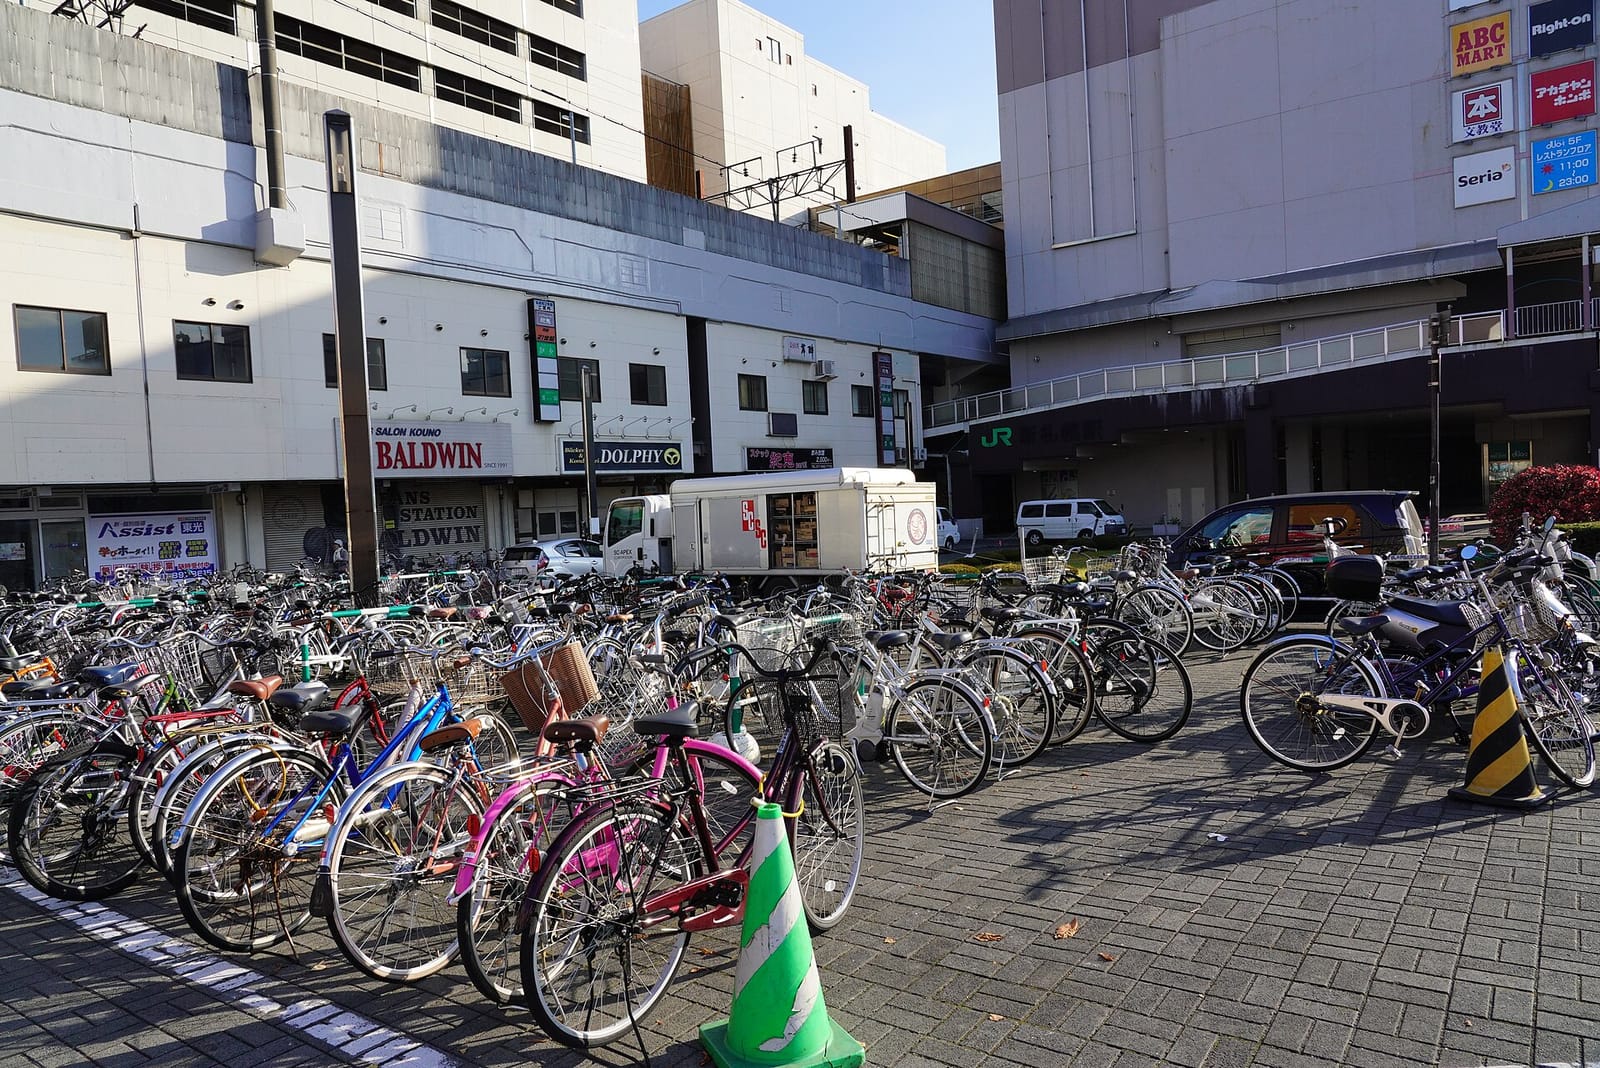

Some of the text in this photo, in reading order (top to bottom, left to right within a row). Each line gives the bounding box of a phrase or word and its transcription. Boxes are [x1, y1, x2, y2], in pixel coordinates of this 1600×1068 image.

[1532, 13, 1591, 36] Right-on
[1456, 22, 1505, 52] ABC
[1456, 43, 1505, 67] MART
[1535, 79, 1591, 99] アカチャン
[1467, 94, 1498, 118] 本
[1464, 121, 1502, 138] 文教堂
[1568, 136, 1582, 145] 5F
[1536, 144, 1592, 161] レストランフロア
[1560, 159, 1589, 170] 11:00
[1458, 169, 1503, 187] Seria
[1559, 175, 1589, 187] 23:00
[375, 427, 407, 436] SALON
[409, 428, 442, 437] KOUNO
[981, 427, 1013, 448] JR
[375, 441, 482, 470] BALDWIN
[601, 448, 664, 464] DOLPHY
[400, 506, 478, 522] STATION
[98, 521, 175, 538] Assist
[182, 522, 204, 533] 東光
